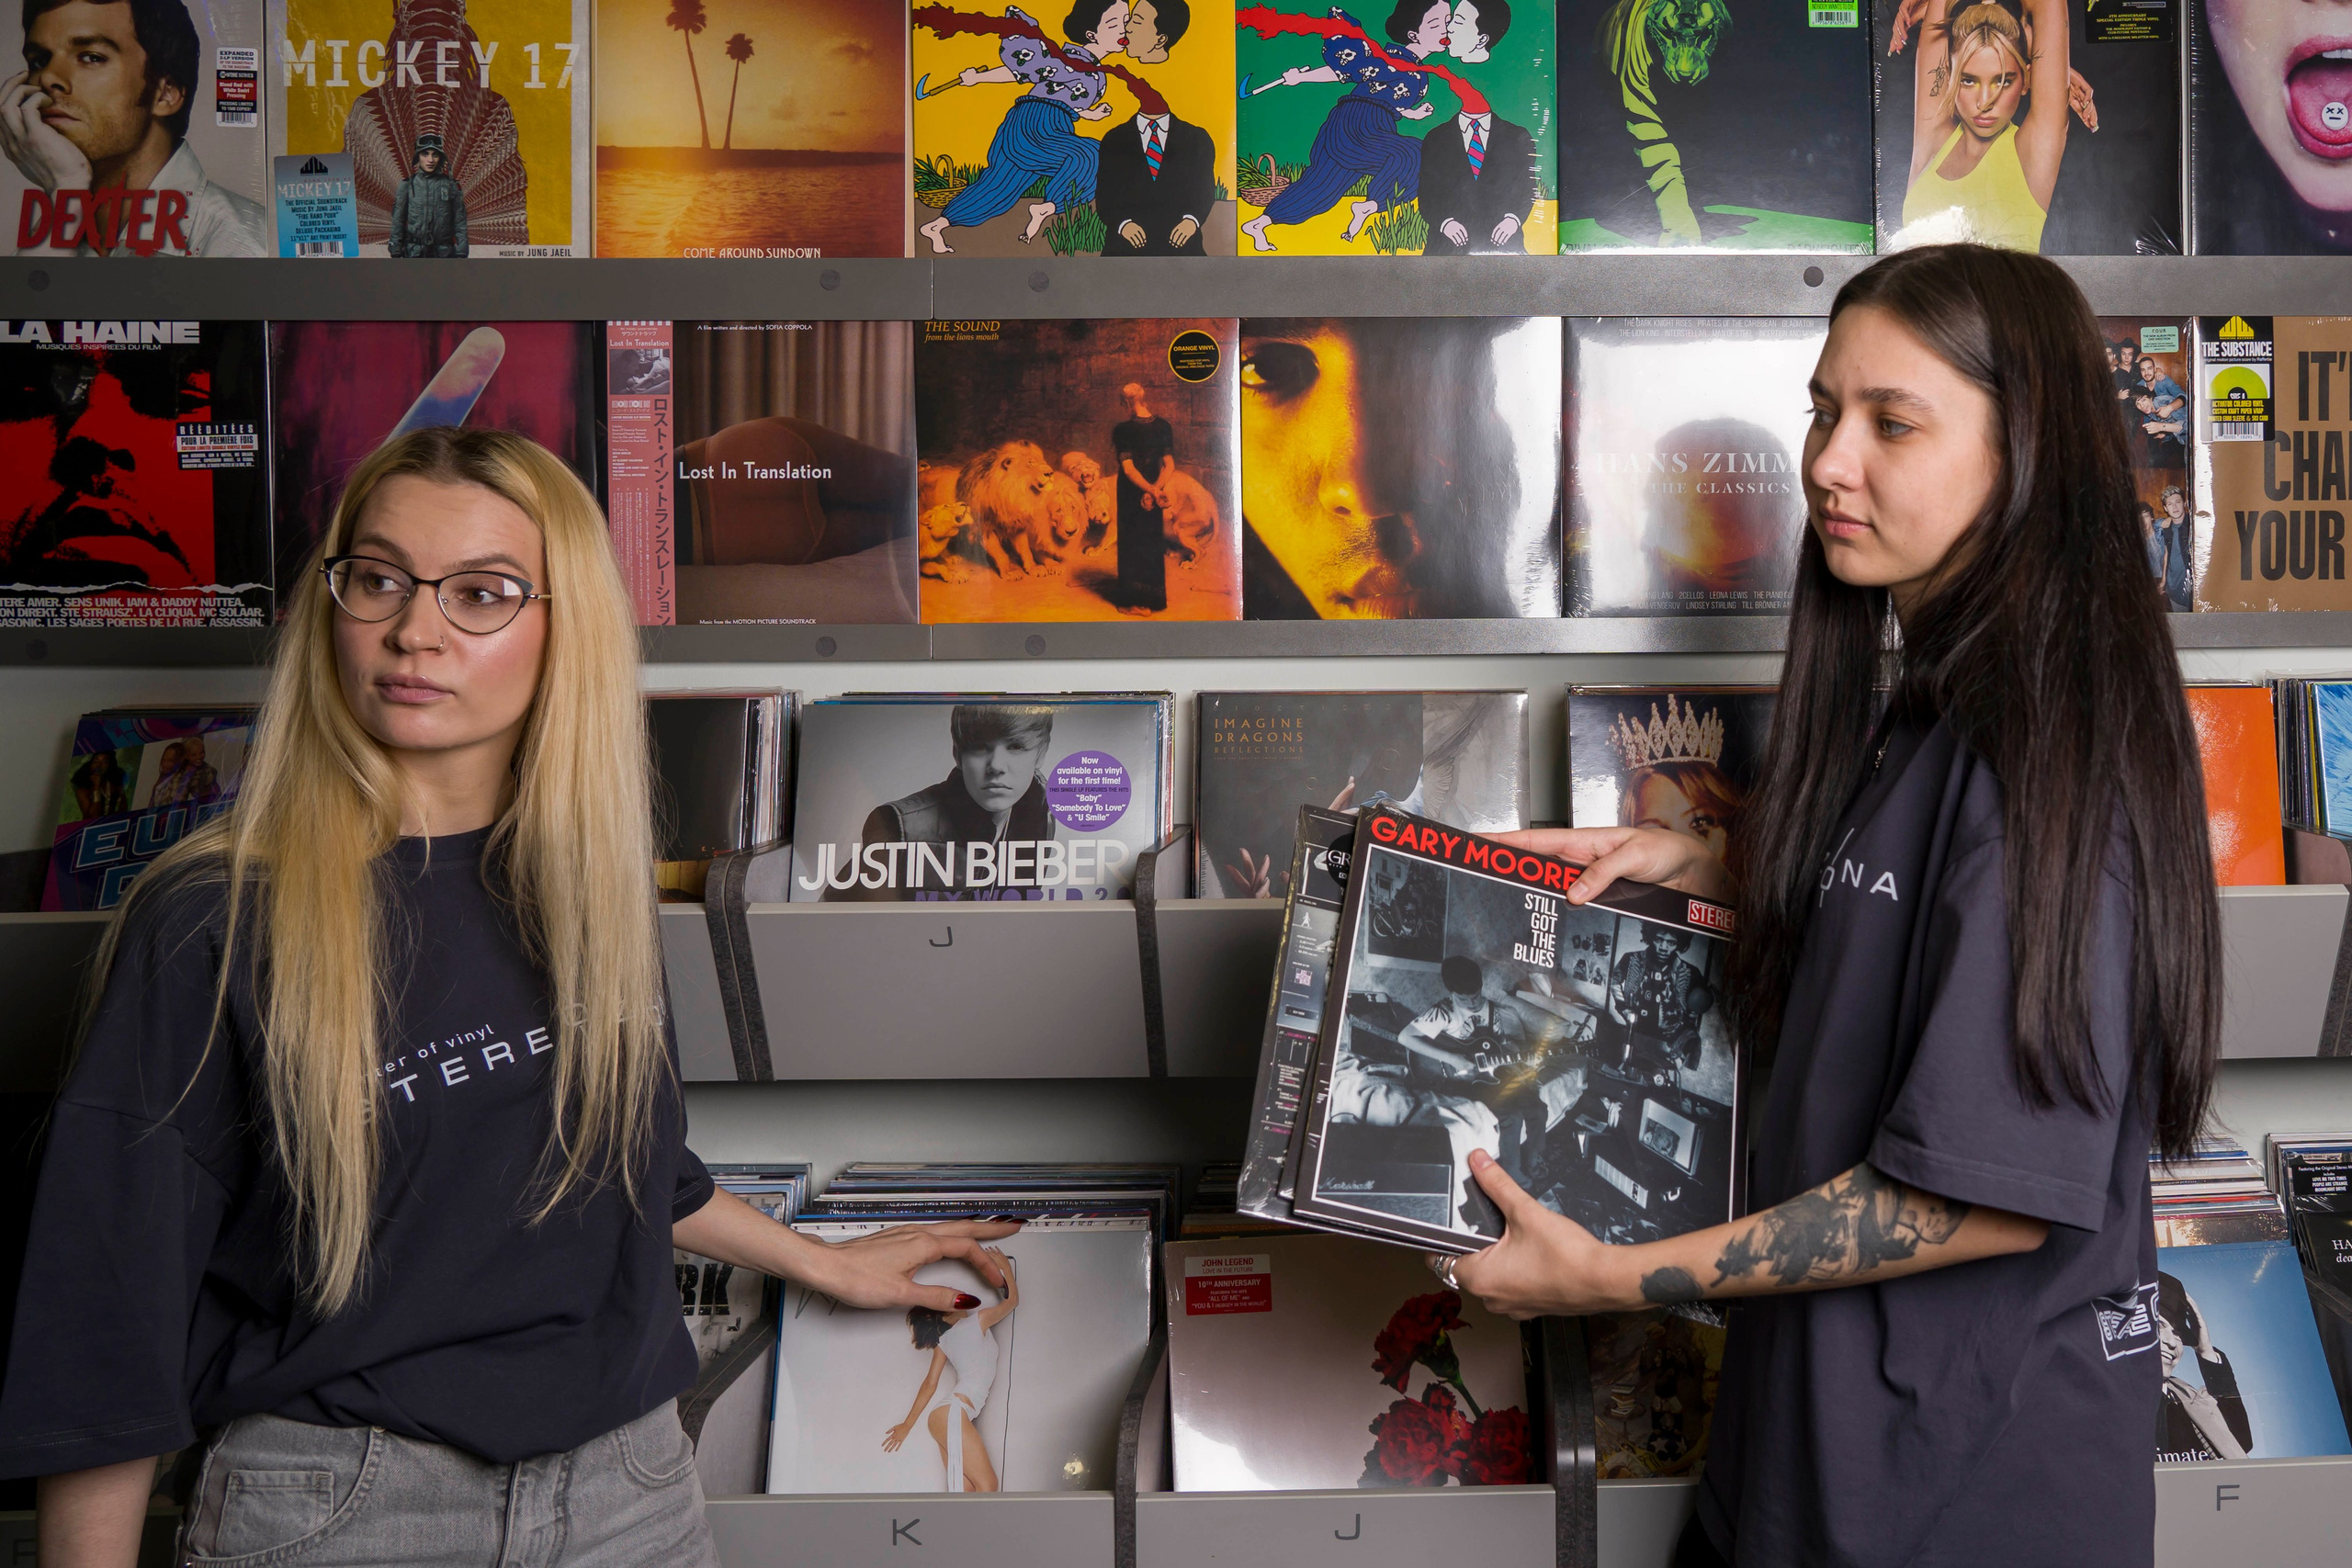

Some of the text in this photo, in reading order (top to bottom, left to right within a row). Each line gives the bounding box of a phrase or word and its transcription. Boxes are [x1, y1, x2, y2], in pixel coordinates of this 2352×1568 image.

[283, 39, 581, 89] MICKEY 17
[277, 182, 351, 198] MICKEY 17
[17, 189, 187, 254] DEXTER
[527, 248, 548, 257] JUNG
[550, 248, 571, 257] JAEIL
[684, 247, 821, 258] COME AROUND SUNDOWN
[0, 321, 199, 344] LA HAINE
[924, 321, 1001, 332] THE SOUND
[924, 333, 942, 344] from
[976, 333, 999, 341] mouth
[2201, 341, 2272, 357] THE SUBSTANCE
[2298, 351, 2352, 421] IT'
[181, 436, 197, 445] POUR
[209, 435, 237, 444] PREMIÈRE
[679, 460, 831, 479] Lost In Translation
[1596, 453, 1797, 473] HANS ZIMM
[2264, 431, 2352, 502] CHA
[1652, 482, 1791, 493] THE CLASSICS
[2234, 510, 2345, 581] YOUR
[28, 598, 62, 607] AMER.
[64, 598, 93, 607] SENS
[96, 598, 124, 606] UNIK.
[128, 598, 147, 606] IAM
[150, 597, 159, 606] &
[162, 598, 198, 606] DADDY
[201, 598, 244, 606] NUTTEA.
[17, 608, 58, 617] DIREKT.
[61, 608, 81, 617] STE
[139, 608, 153, 616] LA
[154, 607, 197, 618] CLIQUA.
[199, 607, 217, 617] MC
[220, 607, 265, 617] SOLAAR.
[47, 618, 68, 627] LES
[69, 617, 104, 627] SAGES
[107, 617, 147, 627] POETES
[150, 618, 164, 626] DE
[166, 618, 180, 626] LA
[183, 618, 208, 626] RUE.
[209, 618, 264, 626] ASSASSIN.
[1215, 718, 1303, 728] IMAGINE
[1215, 732, 1303, 742] DRAGONS
[1104, 767, 1123, 775] vinyl
[1052, 804, 1092, 812] "Somebody
[1104, 804, 1125, 812] Love"
[1076, 795, 1102, 803] "Baby"
[1371, 816, 1464, 860] GARY
[798, 840, 1130, 890] JUSTIN BIEBER
[1524, 893, 1558, 917] STILL
[1531, 912, 1557, 933] GOT
[929, 926, 953, 947] J
[1532, 930, 1555, 951] THE
[1513, 942, 1555, 968] BLUES
[418, 1042, 437, 1058] of
[445, 1024, 494, 1049] vinyl
[1202, 1258, 1253, 1267] JOHN LEGEND
[1214, 1279, 1261, 1287] ANNIVERSARY
[2217, 1484, 2240, 1511] F
[892, 1518, 922, 1545] K
[1335, 1514, 1360, 1540] J
